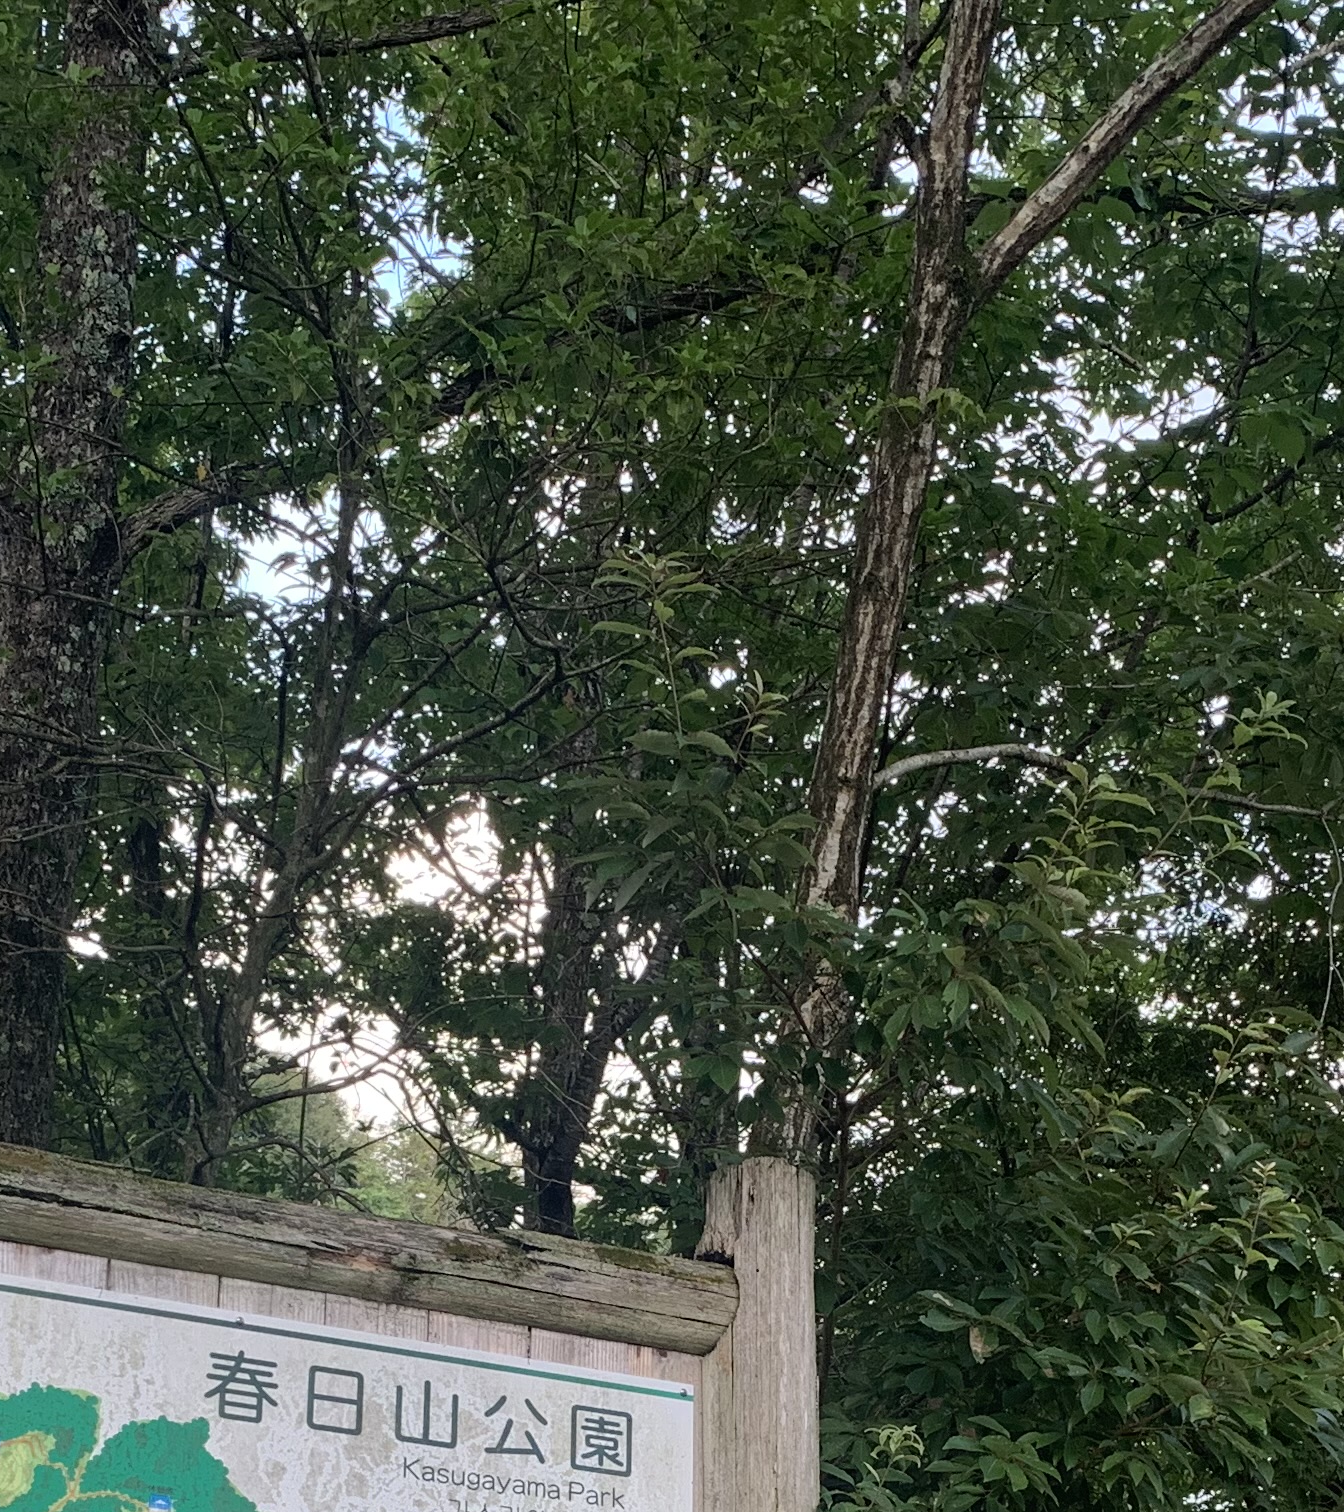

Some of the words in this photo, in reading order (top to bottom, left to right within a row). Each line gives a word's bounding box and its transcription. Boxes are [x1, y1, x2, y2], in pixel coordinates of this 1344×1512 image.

[204, 1350, 633, 1477] 春日山公園
[402, 1456, 562, 1501] Kasugayama
[567, 1481, 626, 1510] Park
